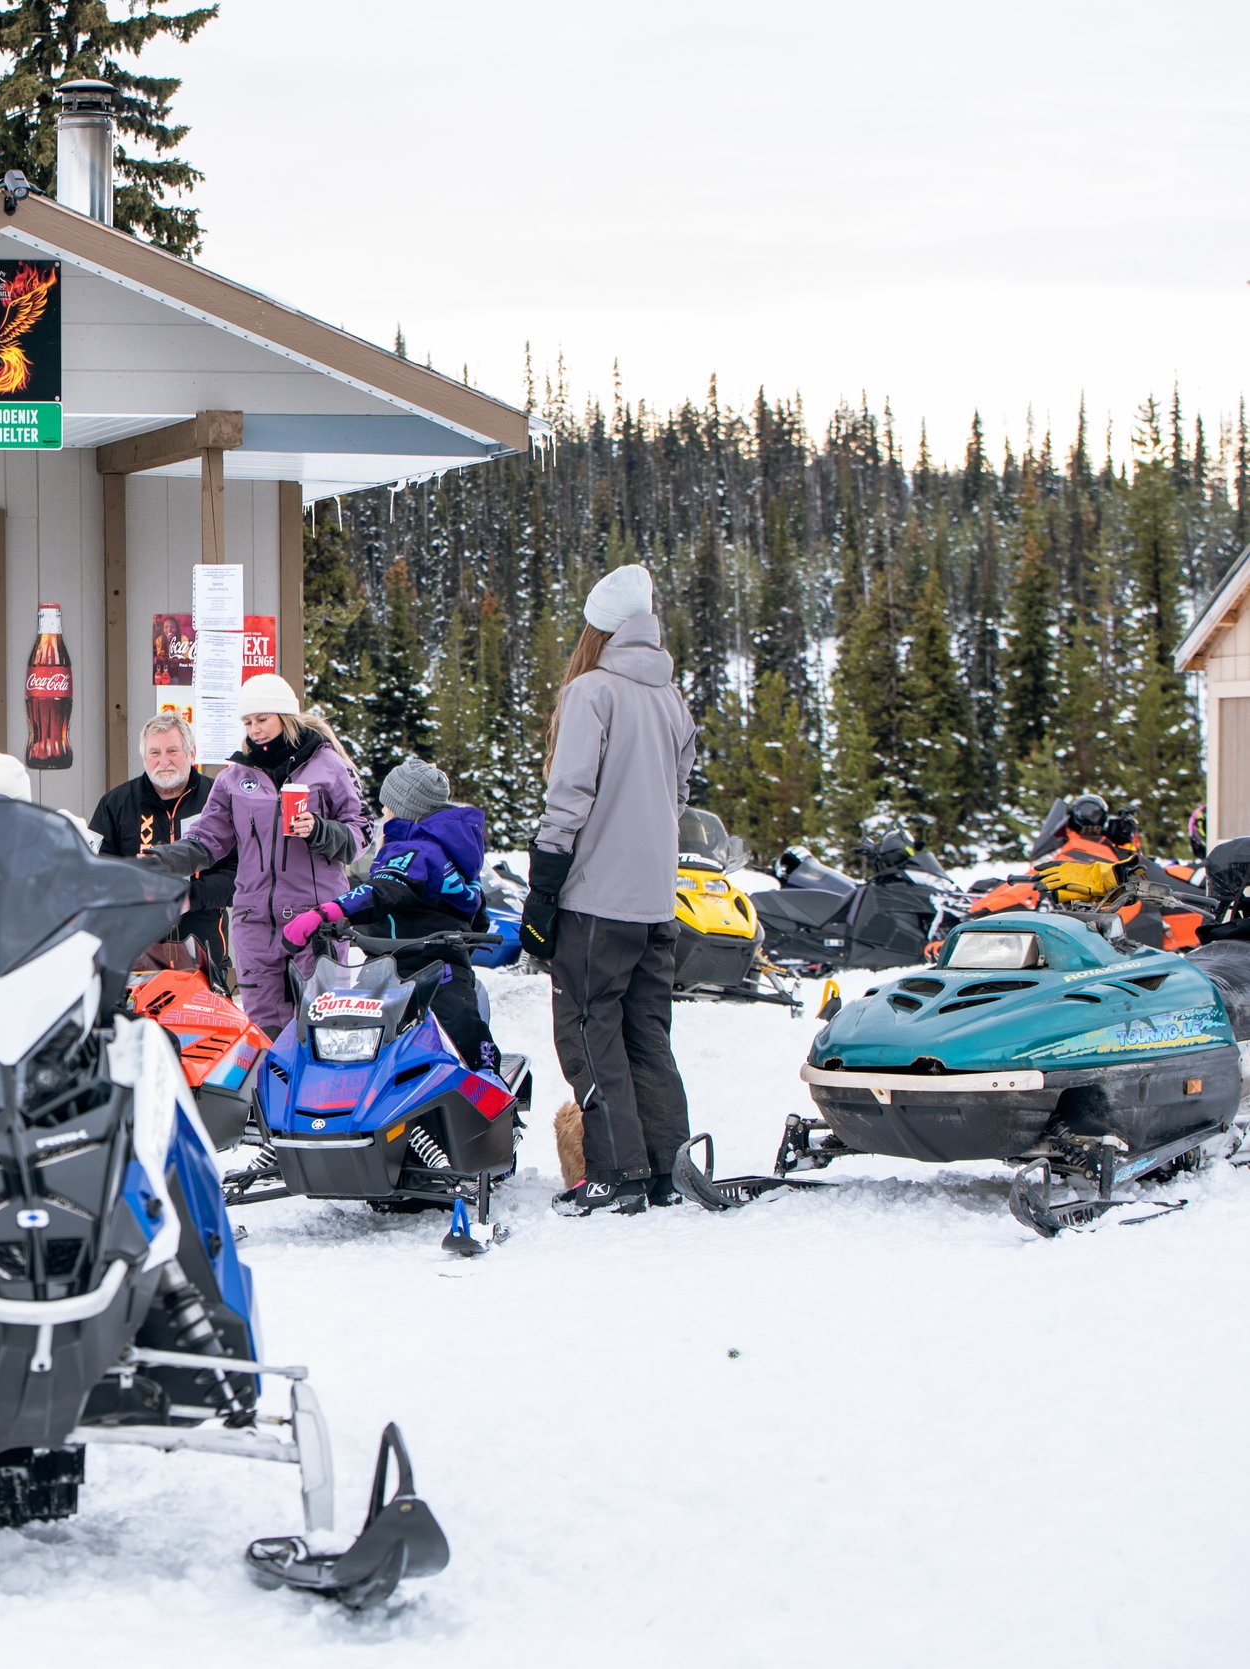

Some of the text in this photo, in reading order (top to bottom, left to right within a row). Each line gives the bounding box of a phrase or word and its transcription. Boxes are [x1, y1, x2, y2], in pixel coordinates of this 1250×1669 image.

[243, 636, 270, 656] EXT
[243, 655, 275, 667] LLENGE
[26, 672, 70, 691] Coca-Cola
[317, 999, 382, 1011] OUTLAW
[1116, 1024, 1179, 1048] TOURING
